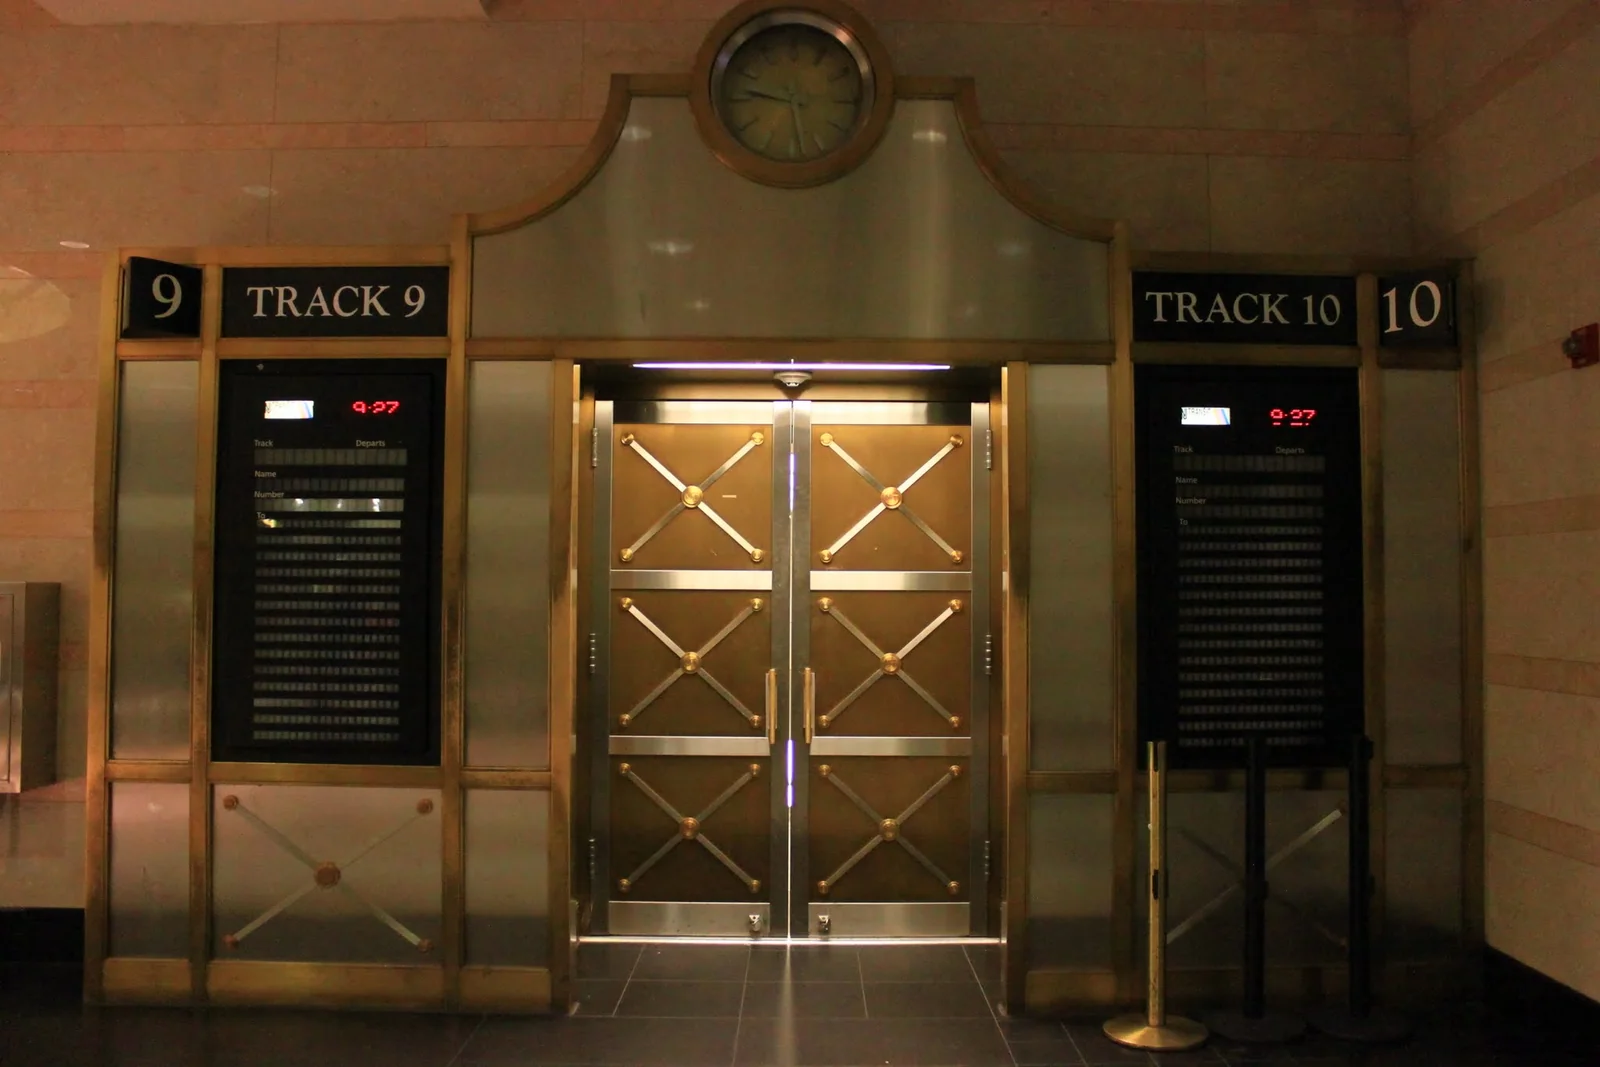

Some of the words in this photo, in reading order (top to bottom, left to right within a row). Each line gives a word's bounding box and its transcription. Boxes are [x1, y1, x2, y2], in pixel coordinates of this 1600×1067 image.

[151, 273, 183, 318] 9
[246, 285, 391, 317] TRACK
[404, 284, 427, 318] 9
[1145, 291, 1290, 325] TRACK
[1303, 294, 1342, 327] 10
[1381, 279, 1442, 334] 10
[352, 400, 400, 415] 9:27
[254, 439, 274, 447] Track
[355, 439, 386, 449] Departs
[1173, 445, 1194, 453] Track
[1275, 446, 1305, 455] Departs
[254, 470, 277, 478] Name
[1175, 476, 1198, 484] Name
[254, 490, 285, 498] Number
[1175, 496, 1207, 505] Number
[256, 512, 266, 520] To
[1179, 518, 1189, 526] To
